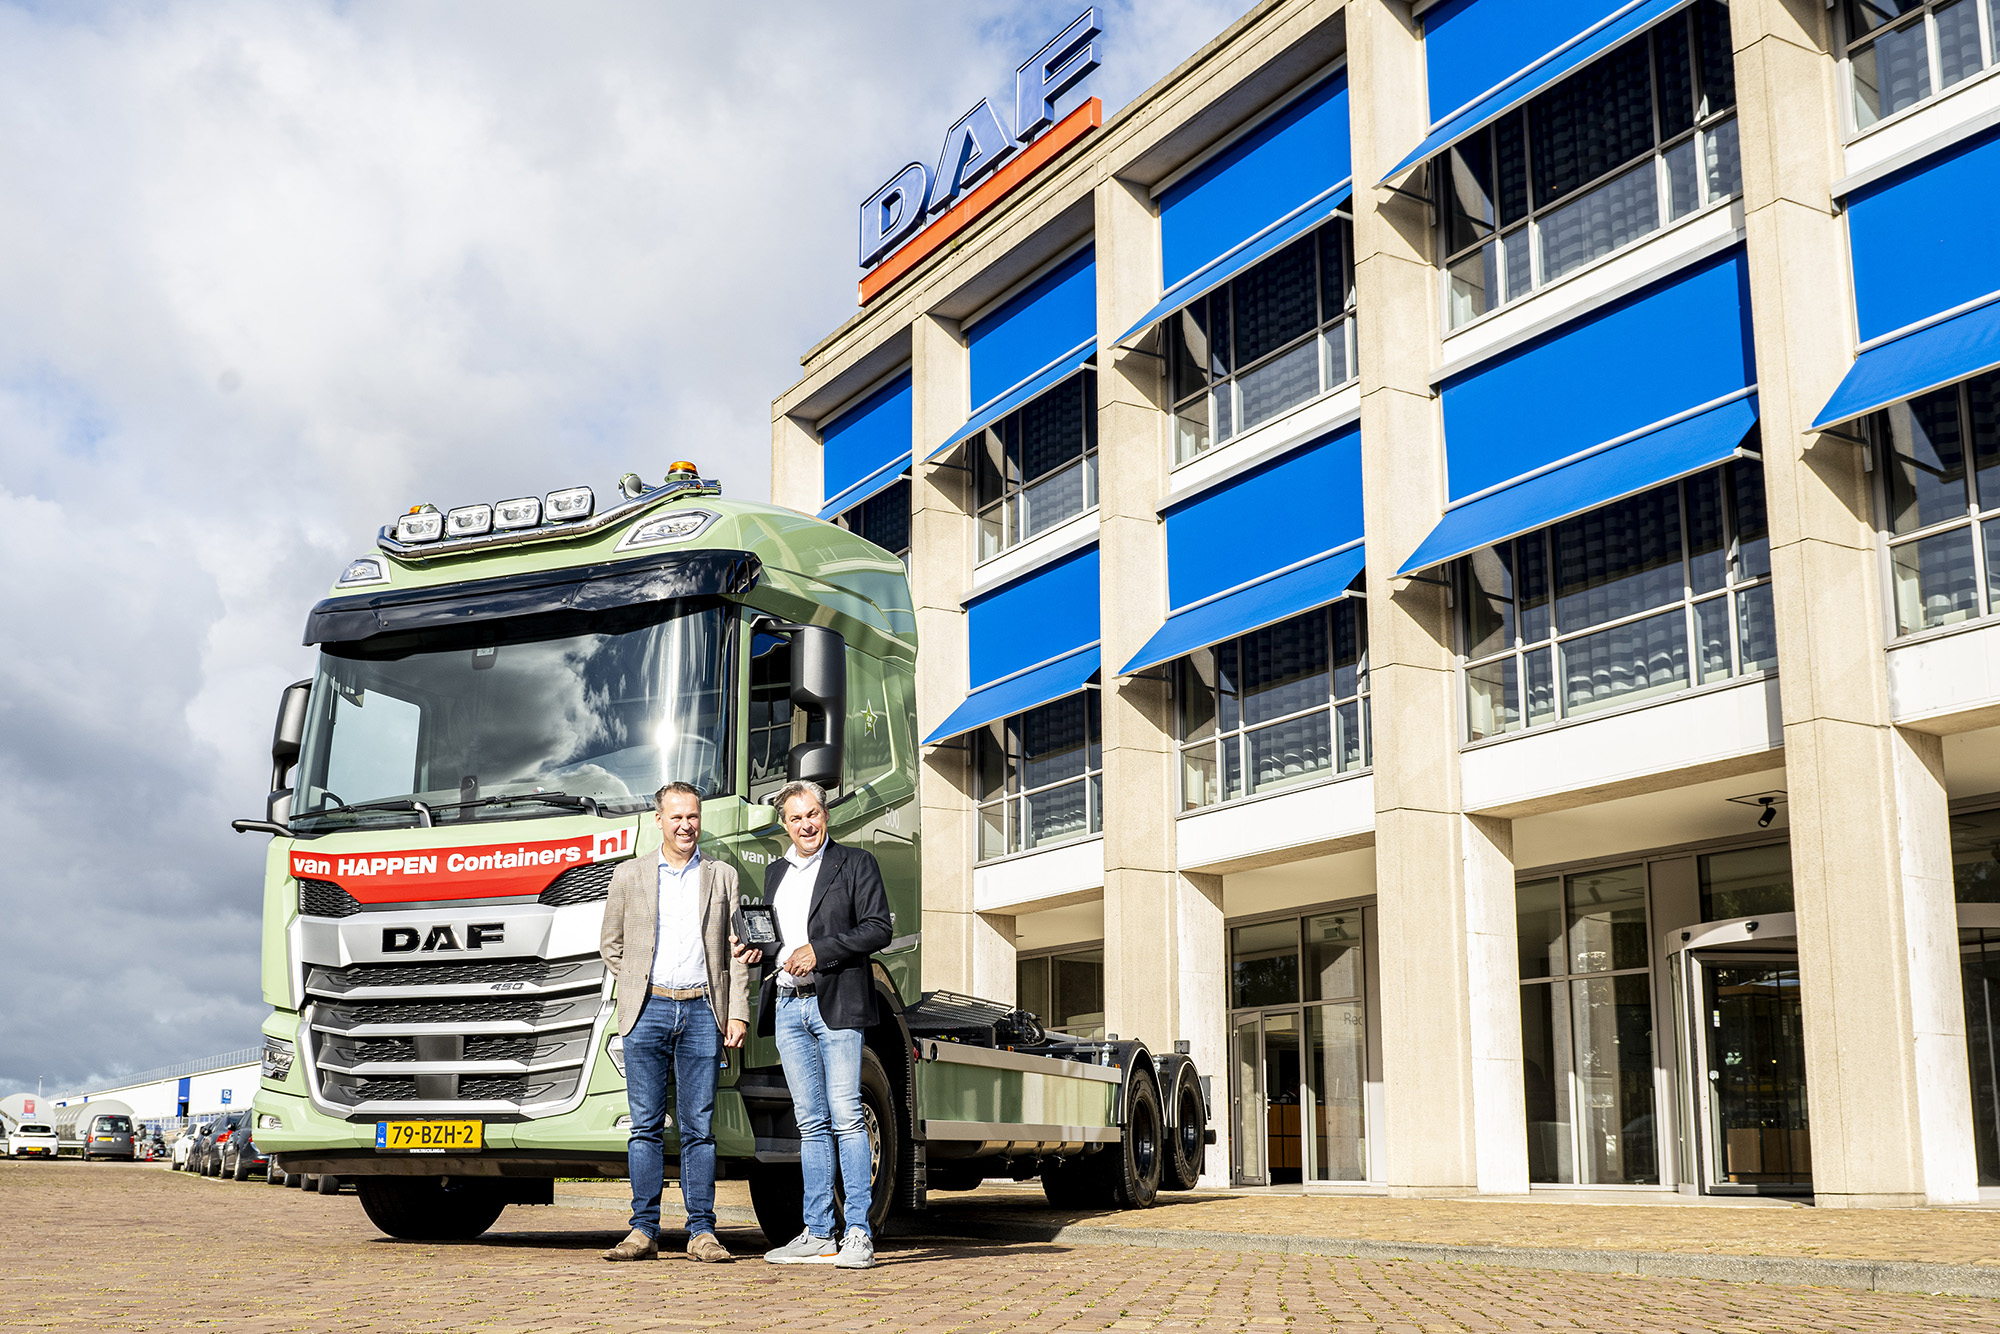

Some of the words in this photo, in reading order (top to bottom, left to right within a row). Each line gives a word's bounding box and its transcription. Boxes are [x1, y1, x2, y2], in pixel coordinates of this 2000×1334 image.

[859, 6, 1103, 269] DAF
[293, 858, 331, 875] van
[338, 855, 437, 876] HAPPEN
[447, 847, 581, 872] Containers
[741, 850, 765, 865] van
[382, 922, 505, 954] DAF
[490, 982, 524, 991] 450
[393, 1125, 474, 1144] 79-BZH-2
